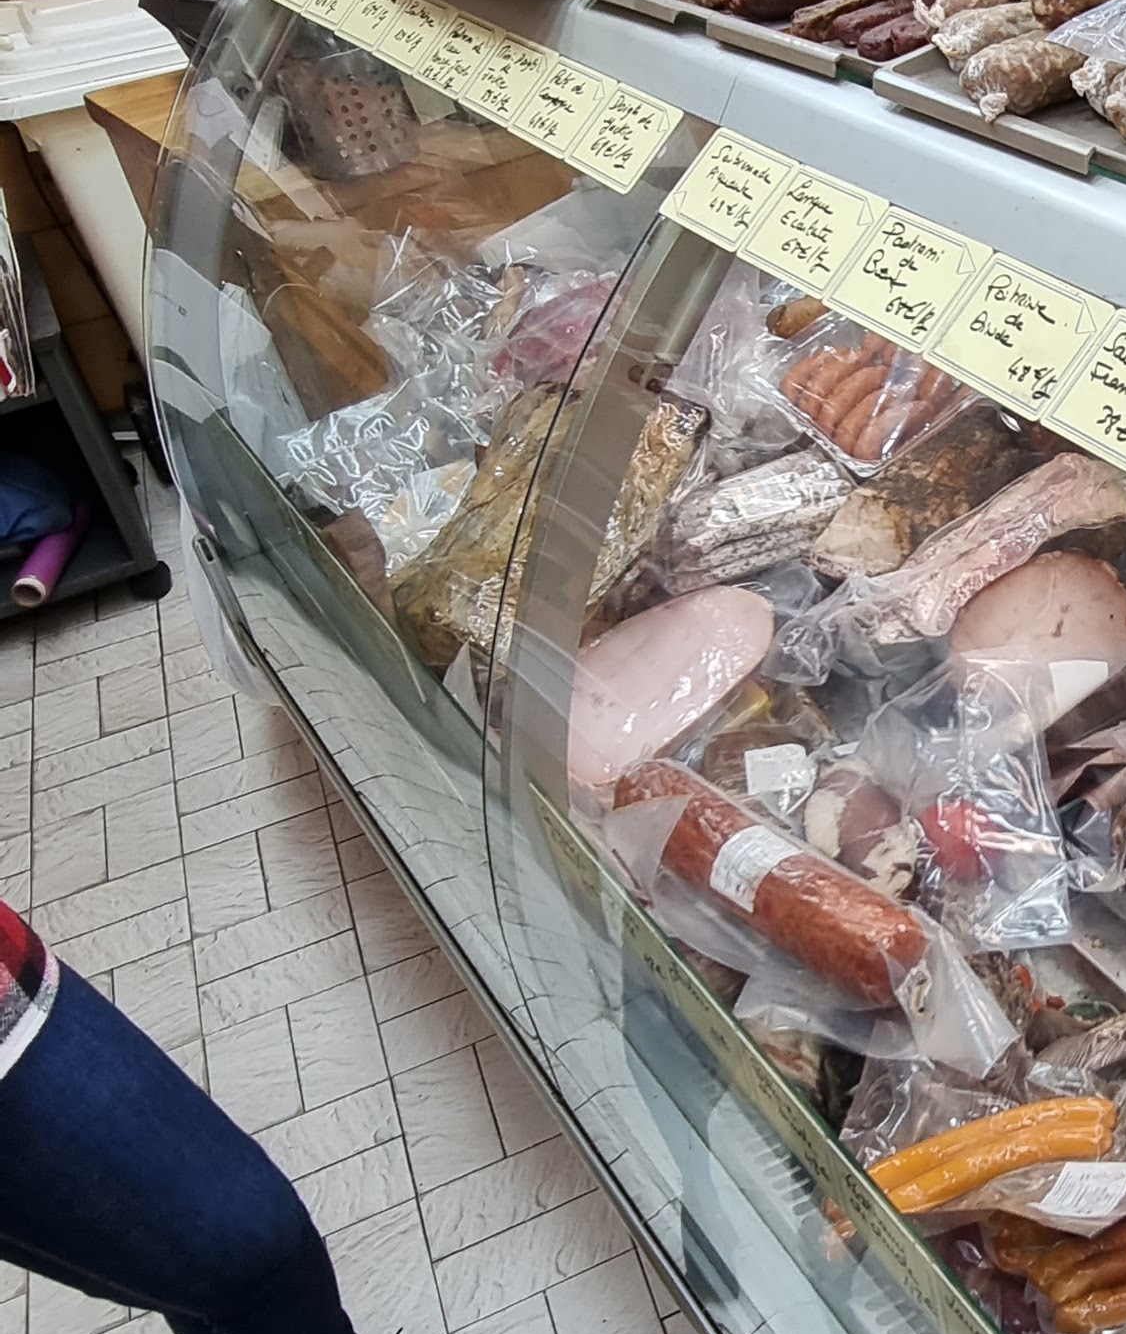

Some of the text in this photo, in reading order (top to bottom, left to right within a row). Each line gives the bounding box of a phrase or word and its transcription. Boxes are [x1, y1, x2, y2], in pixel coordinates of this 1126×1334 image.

[637, 112, 655, 132] de
[882, 221, 946, 263] Pastrami
[899, 253, 918, 272] de
[984, 273, 1056, 325] Poitrine
[1004, 312, 1026, 331] de
